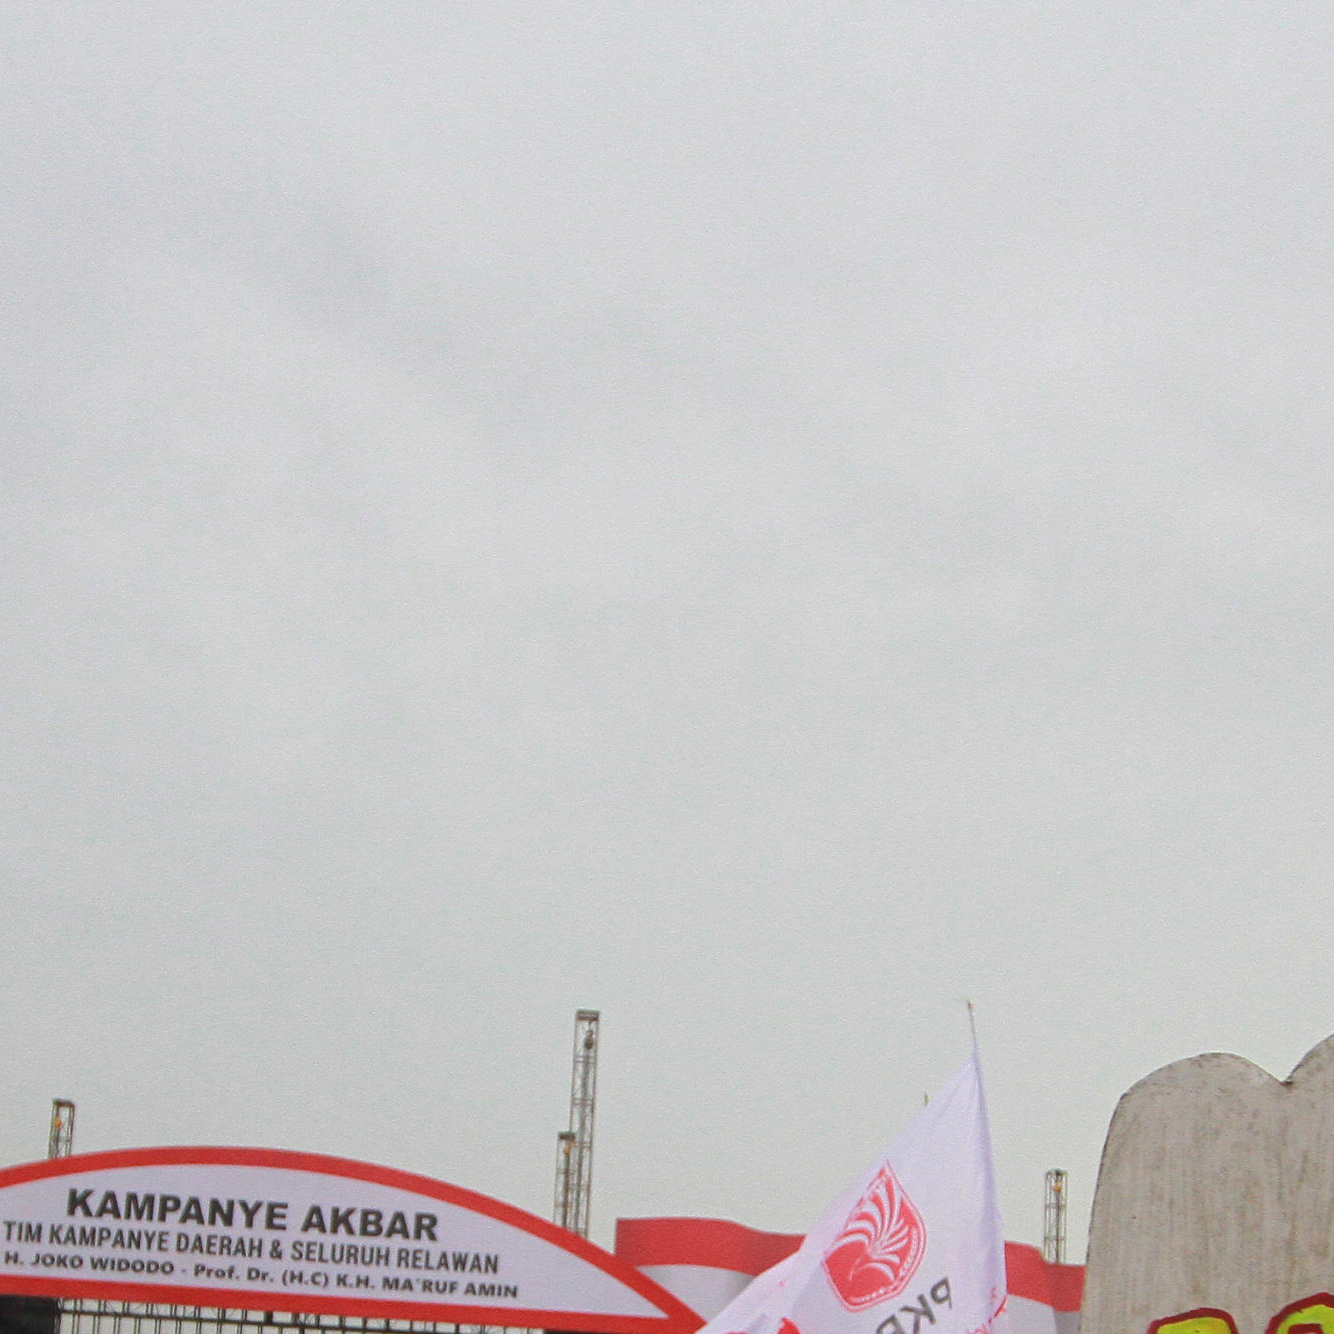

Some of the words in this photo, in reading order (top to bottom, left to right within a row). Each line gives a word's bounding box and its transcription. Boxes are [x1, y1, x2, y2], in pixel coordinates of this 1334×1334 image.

[67, 1188, 288, 1230] KAMPANYE
[300, 1204, 438, 1241] AKBAR
[2, 1220, 42, 1243] TIM
[49, 1223, 169, 1252] KAMPANYE
[175, 1231, 262, 1259] DAERAH
[269, 1239, 283, 1260] &
[290, 1240, 389, 1268] SELURUH
[396, 1248, 499, 1274] RELAWAN
[4, 1250, 24, 1266] H.
[30, 1252, 83, 1269] JOKO
[90, 1255, 174, 1276] WIDODO
[194, 1263, 240, 1281] Prof.
[247, 1266, 274, 1282] Dr.
[281, 1269, 329, 1287] (H.C)
[336, 1273, 375, 1289] K.H.
[382, 1275, 458, 1294] MA'RUF
[463, 1281, 518, 1298] AMIN
